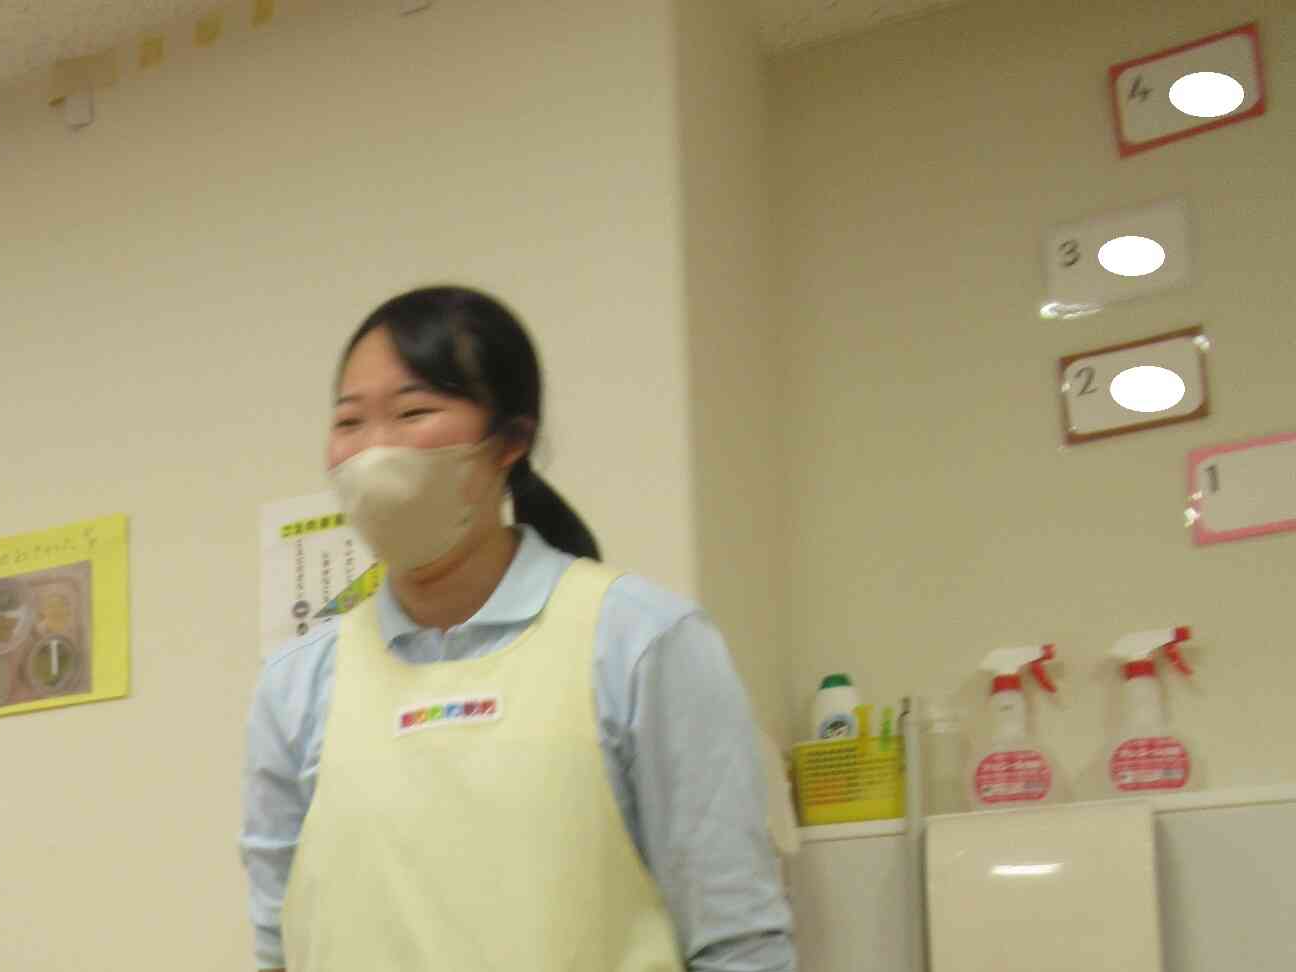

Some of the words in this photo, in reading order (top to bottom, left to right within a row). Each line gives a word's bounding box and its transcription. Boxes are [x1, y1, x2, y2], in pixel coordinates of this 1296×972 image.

[1128, 76, 1153, 103] 4
[1058, 239, 1082, 267] 3
[1073, 366, 1098, 397] 2
[1205, 464, 1220, 493] 1
